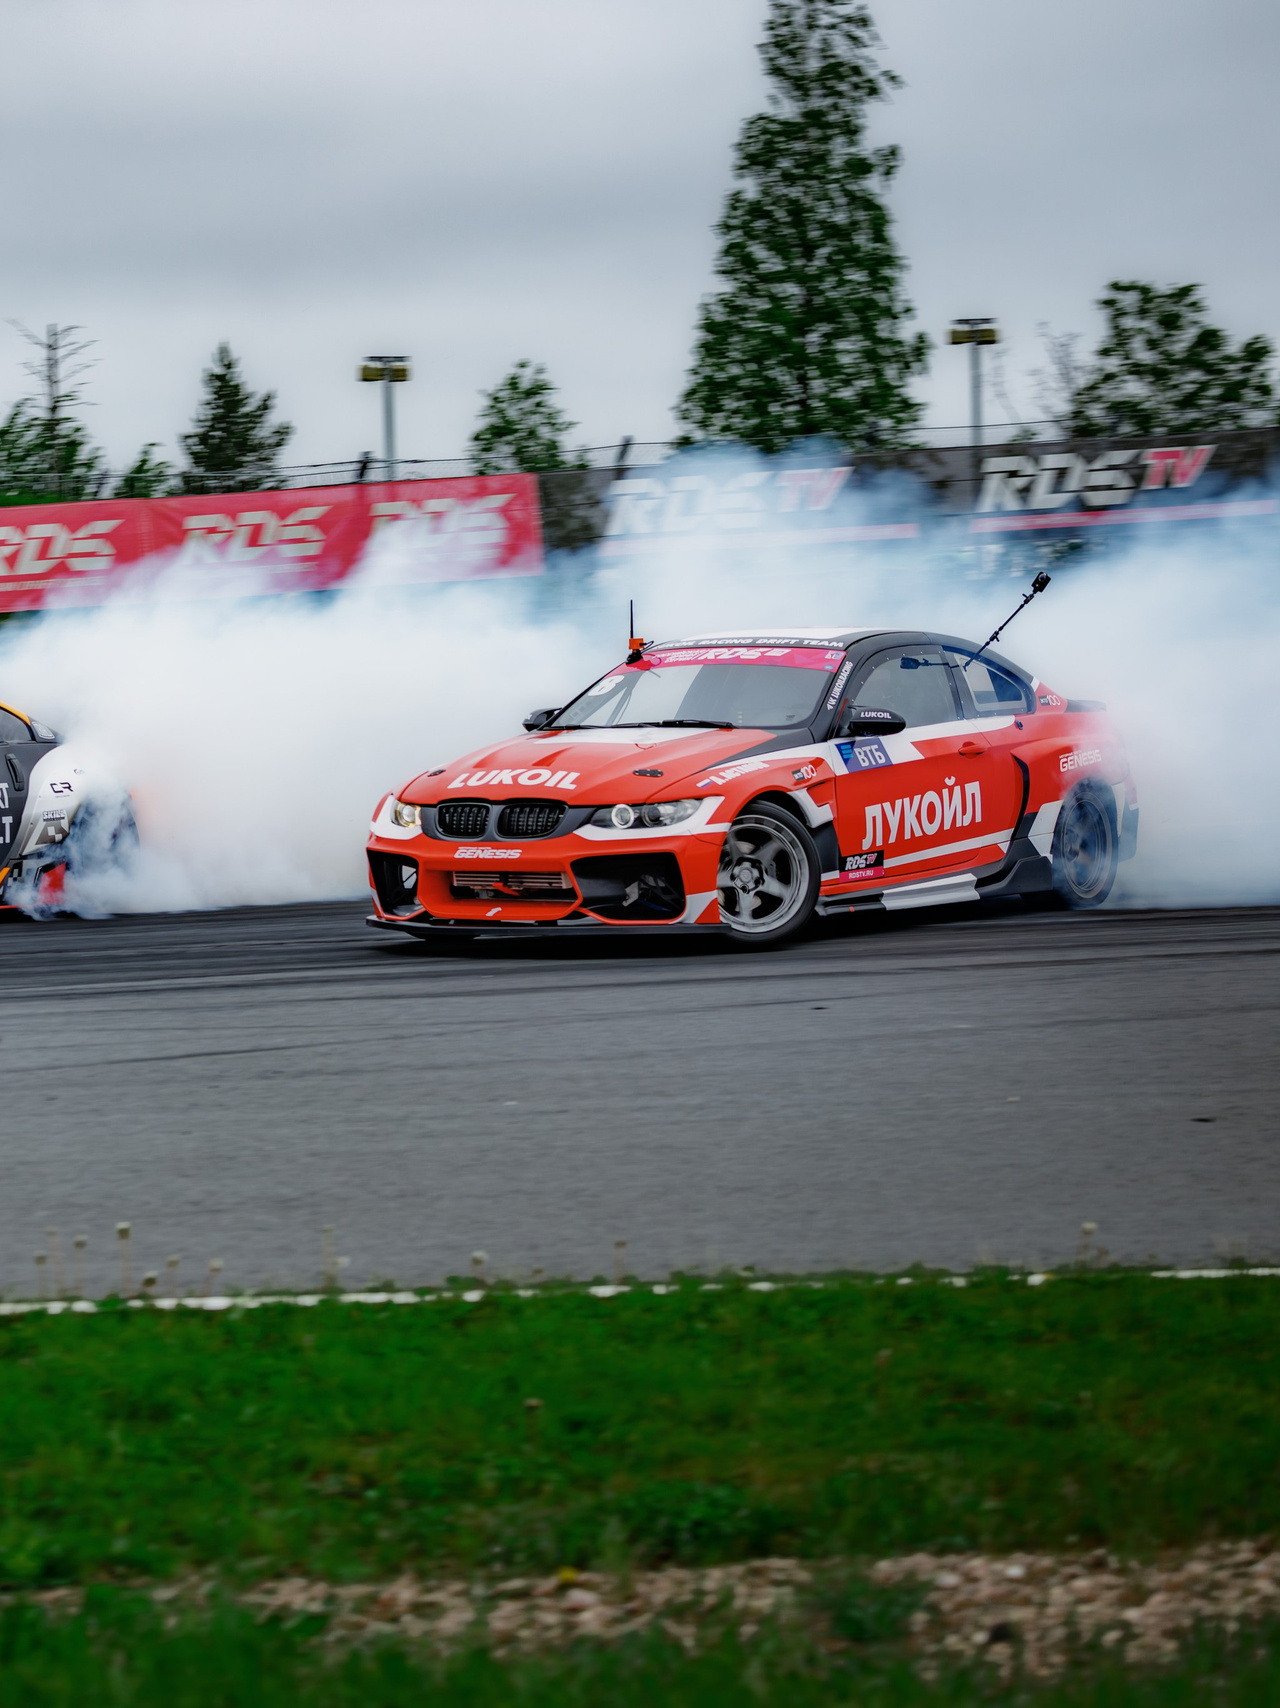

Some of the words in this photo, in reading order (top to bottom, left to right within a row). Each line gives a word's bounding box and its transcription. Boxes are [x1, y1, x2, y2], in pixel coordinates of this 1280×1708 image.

[975, 449, 1143, 514] RDS
[1138, 444, 1218, 489] TV
[803, 640, 844, 648] TEAM
[698, 648, 771, 660] RDS
[860, 711, 891, 719] LUKOIL
[854, 744, 886, 767] ВТБ
[1060, 749, 1102, 772] GENESIS
[447, 769, 580, 790] LUKOIL
[862, 775, 982, 850] ЛУКОЙЛ
[454, 849, 522, 859] GENESIS
[845, 854, 867, 871] RDS
[848, 870, 874, 879] RDSTV.RU
